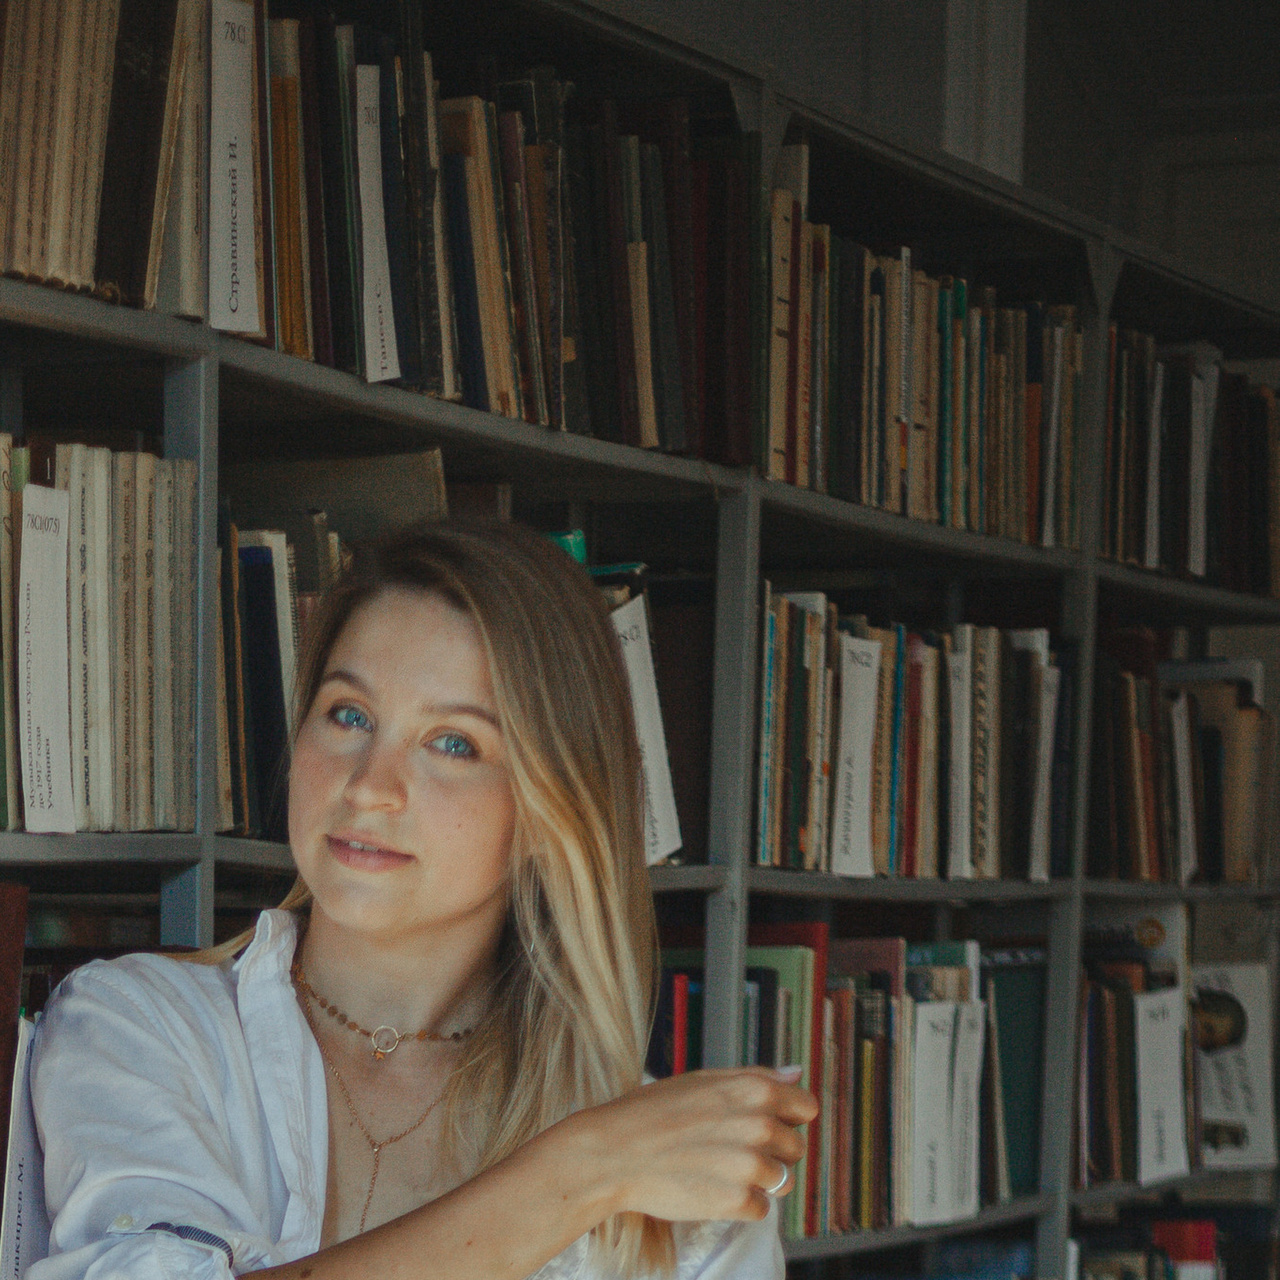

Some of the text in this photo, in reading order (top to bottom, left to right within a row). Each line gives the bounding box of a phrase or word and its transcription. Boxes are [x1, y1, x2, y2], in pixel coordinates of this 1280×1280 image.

[226, 135, 240, 314] Стравинский И.
[23, 582, 36, 809] Музыкальная культура России
[35, 726, 43, 758] года
[35, 762, 43, 791] 1917
[43, 737, 54, 810] Учебники
[16, 1156, 25, 1182] М.
